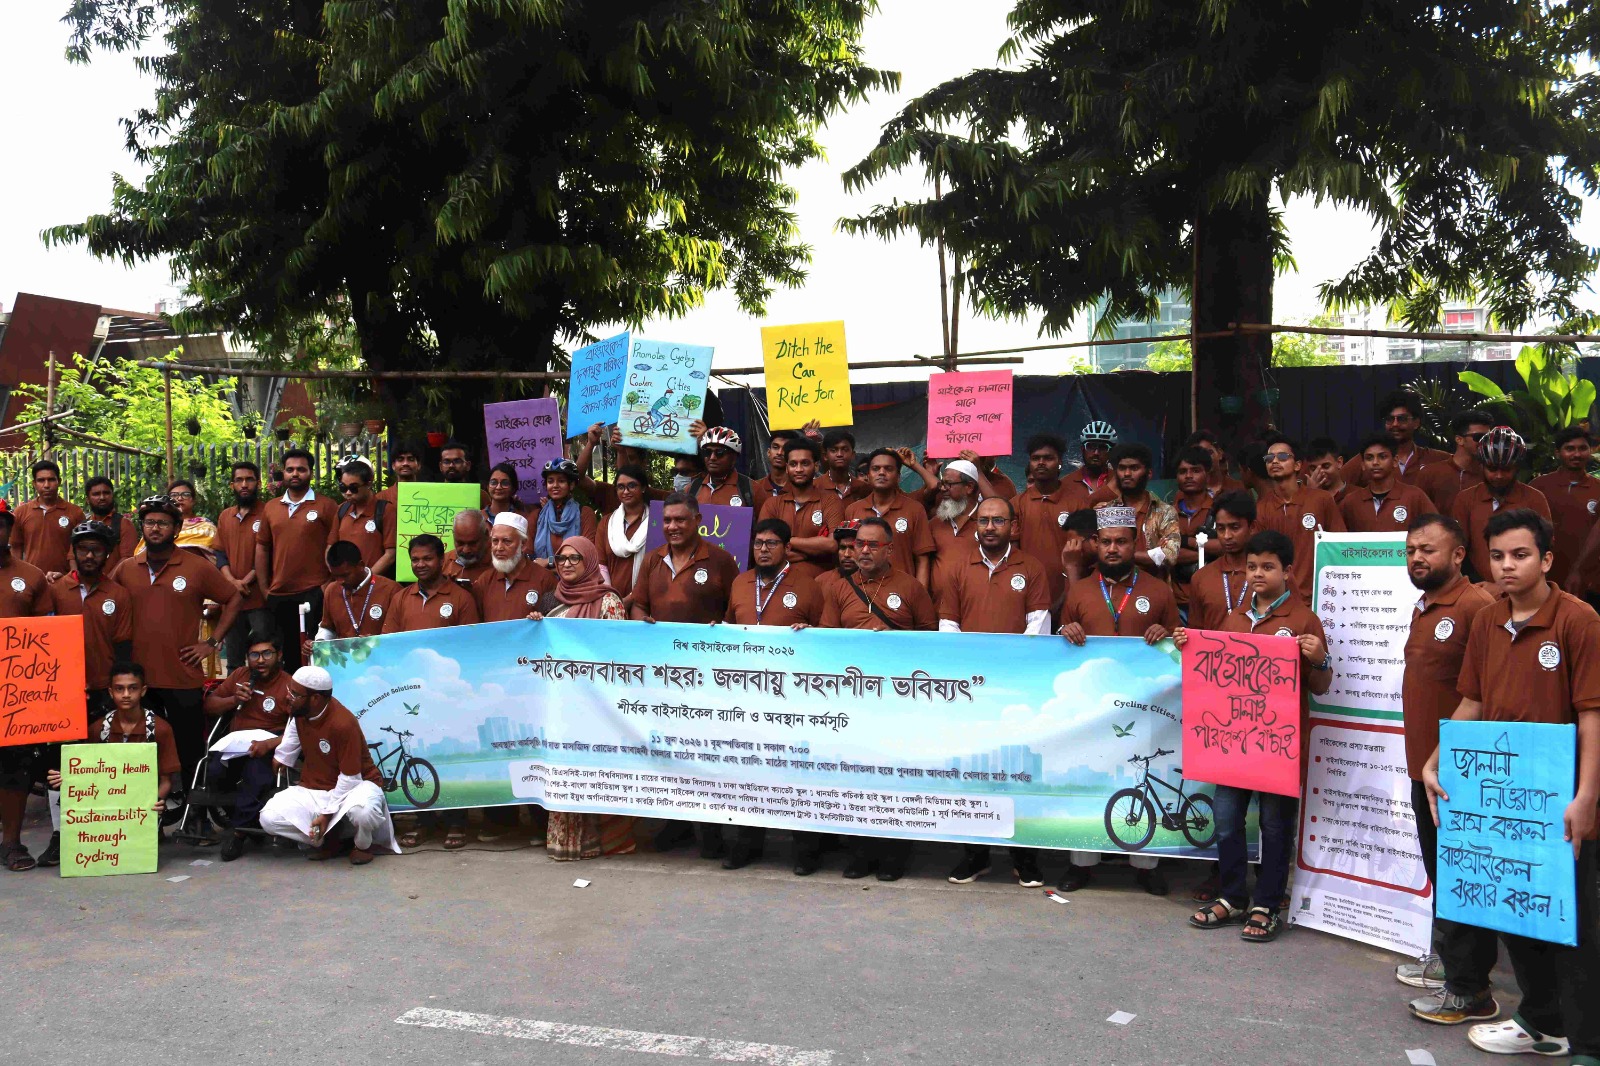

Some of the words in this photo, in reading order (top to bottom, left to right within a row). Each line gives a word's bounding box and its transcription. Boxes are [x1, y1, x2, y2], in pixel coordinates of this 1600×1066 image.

[632, 342, 667, 361] Promotes
[669, 347, 695, 367] Cycling
[775, 337, 809, 359] Ditch
[815, 337, 834, 355] the
[667, 376, 691, 391] Cities
[938, 384, 973, 395] সাইকেল
[978, 383, 1010, 393] চালানো
[777, 386, 809, 411] Ride
[956, 398, 976, 408] মানে
[495, 415, 529, 429] সাইকেল
[533, 415, 552, 427] হোক
[936, 413, 971, 426] প্রকৃতির
[977, 412, 1002, 423] পাশে
[494, 436, 536, 452] পরিবর্তনের
[540, 436, 555, 446] পথ
[945, 430, 982, 443] দাঁড়ানো
[1341, 547, 1394, 558] বাইসাইকেলের
[2, 626, 51, 656] Bike
[673, 639, 688, 651] বিশ্ব
[692, 641, 740, 654] বাইসাইকেল
[743, 642, 765, 655] দিবস
[768, 646, 795, 656] ২০২৬
[1, 655, 60, 681] Today
[1193, 632, 1298, 694] বাইসাইকেল
[652, 663, 704, 690] শহর:
[712, 667, 787, 699] জলবায়ু
[792, 666, 885, 698] সহনশীল
[890, 670, 985, 702] ভবিষ্যৎ”
[0, 683, 58, 708] Breath
[367, 691, 391, 708] Climate
[391, 683, 421, 695] Solutions
[617, 699, 648, 716] শীর্ষক
[652, 702, 713, 720] বাইসাইকেল
[750, 712, 759, 722] ও
[763, 712, 804, 728] অবস্থান
[808, 711, 849, 732] কর্মসূচি
[1114, 699, 1148, 712] Cycling
[1150, 705, 1177, 722] Cities,
[651, 735, 662, 744] ১১
[664, 735, 677, 746] জুন
[679, 738, 701, 747] ২০২৬
[711, 739, 754, 750] বৃহস্পতিবার
[763, 743, 785, 753] সকাল
[789, 745, 810, 754] ৭:০০
[1451, 732, 1519, 779] জ্বালানী
[69, 757, 117, 780] Promoting
[123, 763, 150, 774] Health
[562, 741, 590, 752] মসজিদ
[592, 744, 618, 754] রোডের
[620, 745, 648, 756] আবাহনী
[650, 749, 671, 759] খেলার
[673, 749, 695, 760] মাঠের
[698, 753, 720, 763] সামনে
[723, 755, 739, 765] এবং
[765, 756, 787, 768] মাঠের
[791, 760, 814, 770] সামনে
[817, 761, 838, 771] থেকে
[840, 761, 875, 775] জিগাতলা
[877, 766, 893, 776] হয়ে
[896, 767, 923, 778] পুনরায়
[926, 768, 960, 779] আবাহনী
[963, 771, 989, 781] খেলার
[991, 770, 1007, 782] মাঠ
[1010, 771, 1032, 783] পর্যন্ত
[68, 783, 100, 802] Equity
[108, 785, 127, 796] and
[589, 781, 620, 792] আইডিয়াল
[622, 784, 633, 793] স্কুল
[641, 786, 668, 795] বাংলাদেশ
[671, 787, 695, 797] সাইকেল
[697, 790, 709, 798] লেন
[849, 802, 866, 812] উত্তরা
[868, 805, 895, 815] সাইকেল
[897, 806, 929, 816] কমিউনিটি
[938, 809, 949, 819] সূর্য
[951, 809, 972, 819] শিশির
[974, 811, 994, 821] রানার্স
[599, 770, 633, 780] বিশ্ববিদ্যালয়
[661, 776, 678, 784] বাজার
[679, 775, 690, 785] উচ্চ
[692, 777, 716, 788] বিদ্যালয়
[723, 782, 737, 790] ঢাকা
[739, 782, 770, 793] আইডিয়াল
[796, 788, 807, 797] স্কুল
[866, 792, 878, 801] হাই
[880, 795, 893, 803] স্কুল
[925, 796, 952, 806] মিডিয়াম
[954, 799, 966, 808] হাই
[969, 800, 982, 809] স্কুল
[1480, 778, 1558, 813] নির্ভরতা
[66, 807, 148, 826] Sustainability
[586, 792, 628, 803] অর্গানাইজেশন
[748, 806, 765, 815] বেটার
[766, 808, 796, 817] বাংলাদেশ
[856, 816, 868, 824] অব
[905, 820, 937, 829] বাংলাদেশ
[77, 829, 127, 847] through
[75, 849, 119, 868] Cycling
